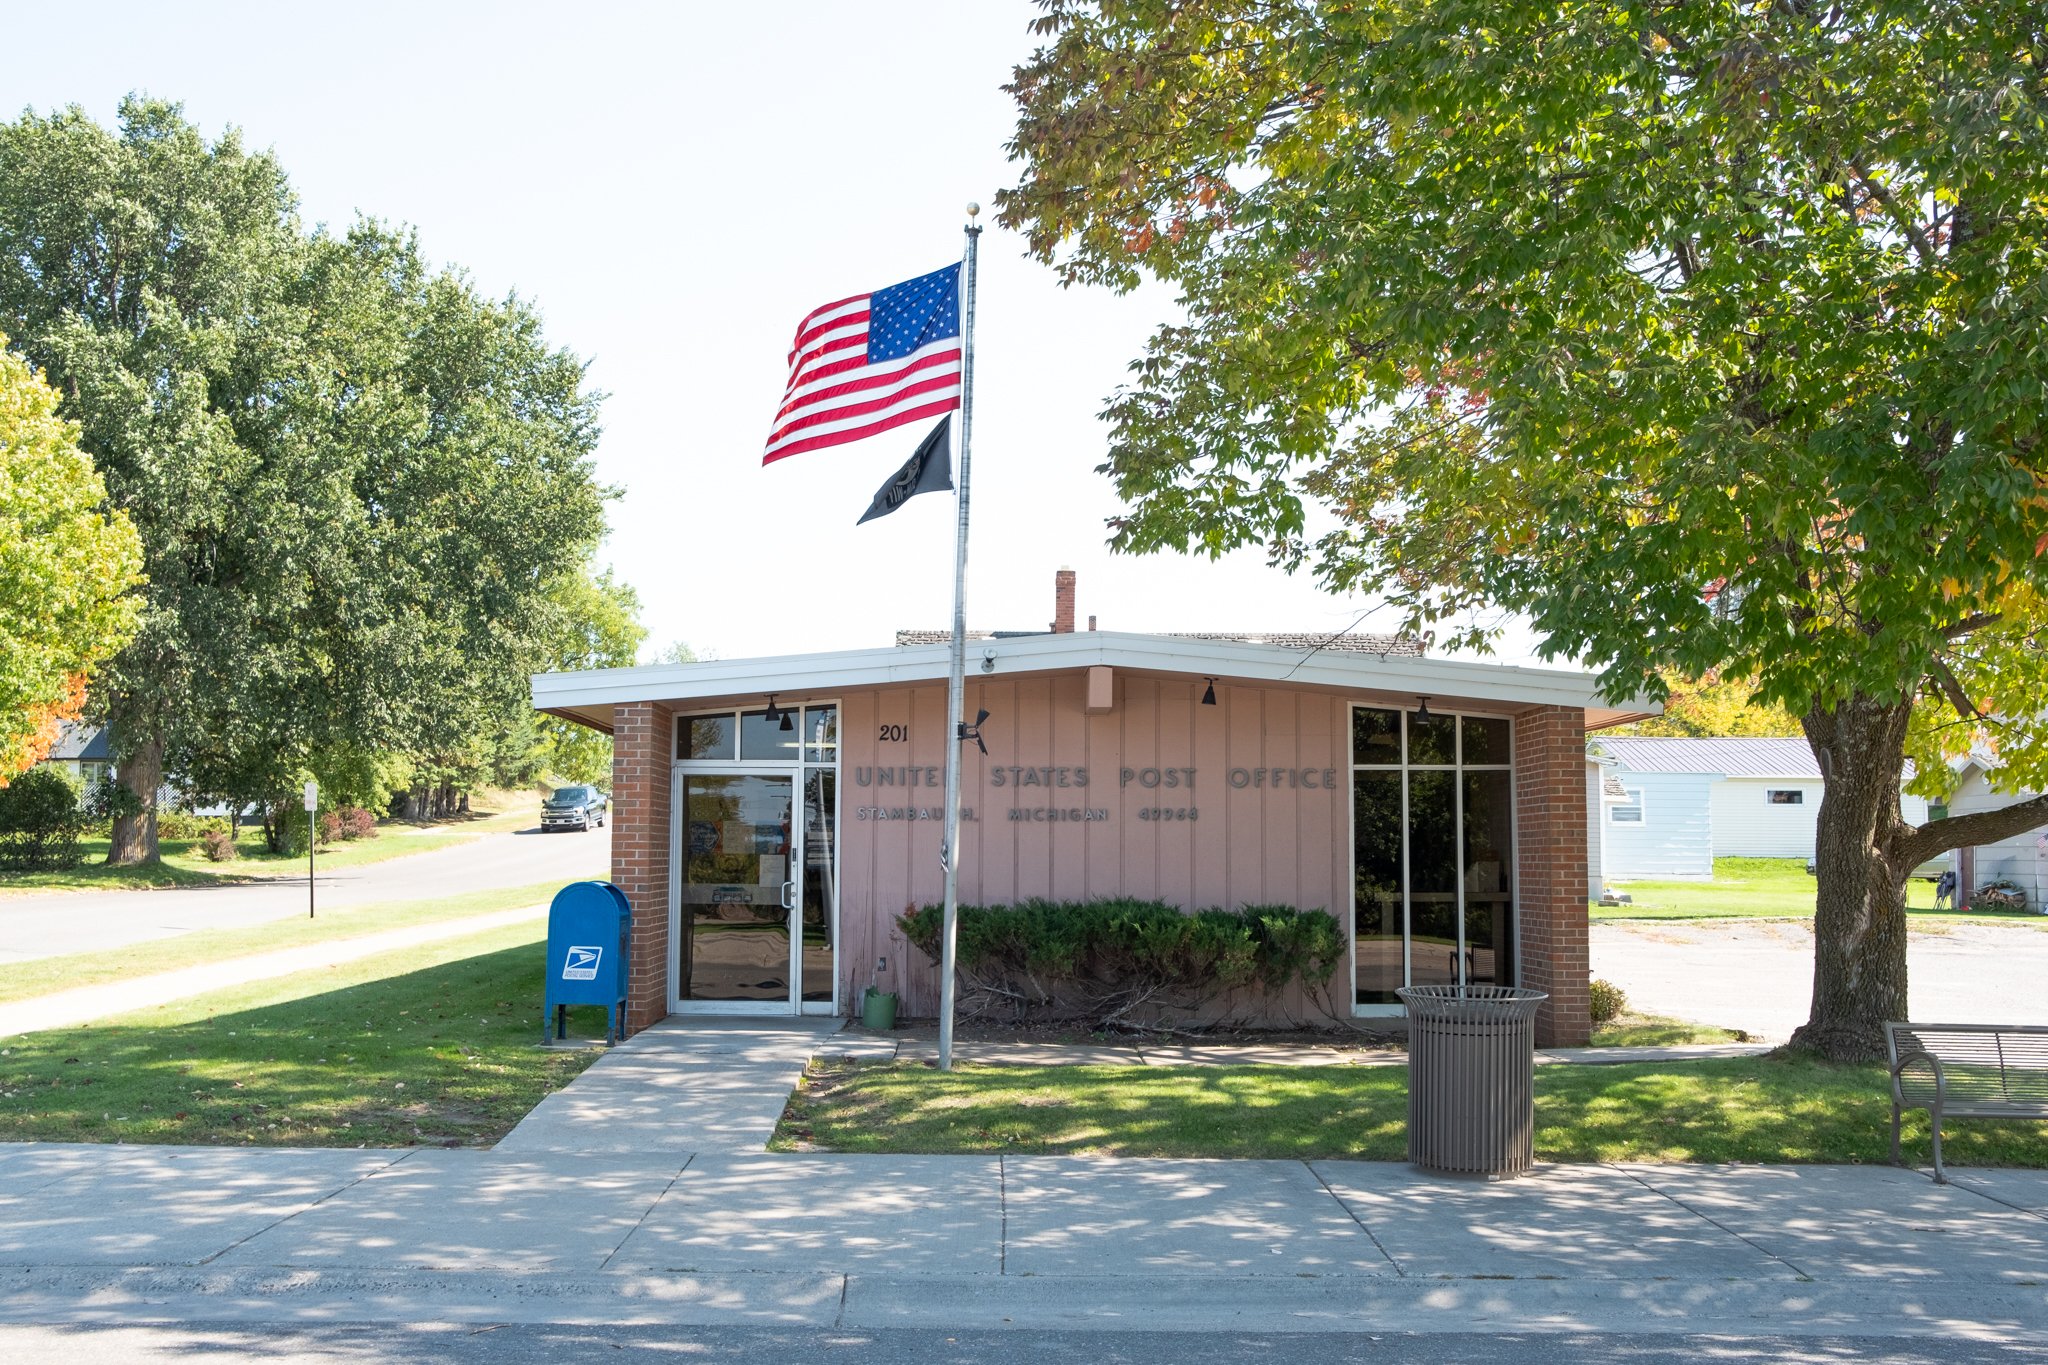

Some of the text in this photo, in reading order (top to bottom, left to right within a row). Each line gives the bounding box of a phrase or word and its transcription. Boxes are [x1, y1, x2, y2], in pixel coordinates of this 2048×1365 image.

[879, 724, 908, 742] 201
[991, 766, 1088, 788] STATES
[1119, 767, 1197, 788] POST
[1228, 767, 1337, 789] OFFICE
[1008, 808, 1107, 822] MICHIGAN
[1138, 807, 1198, 821] 49964
